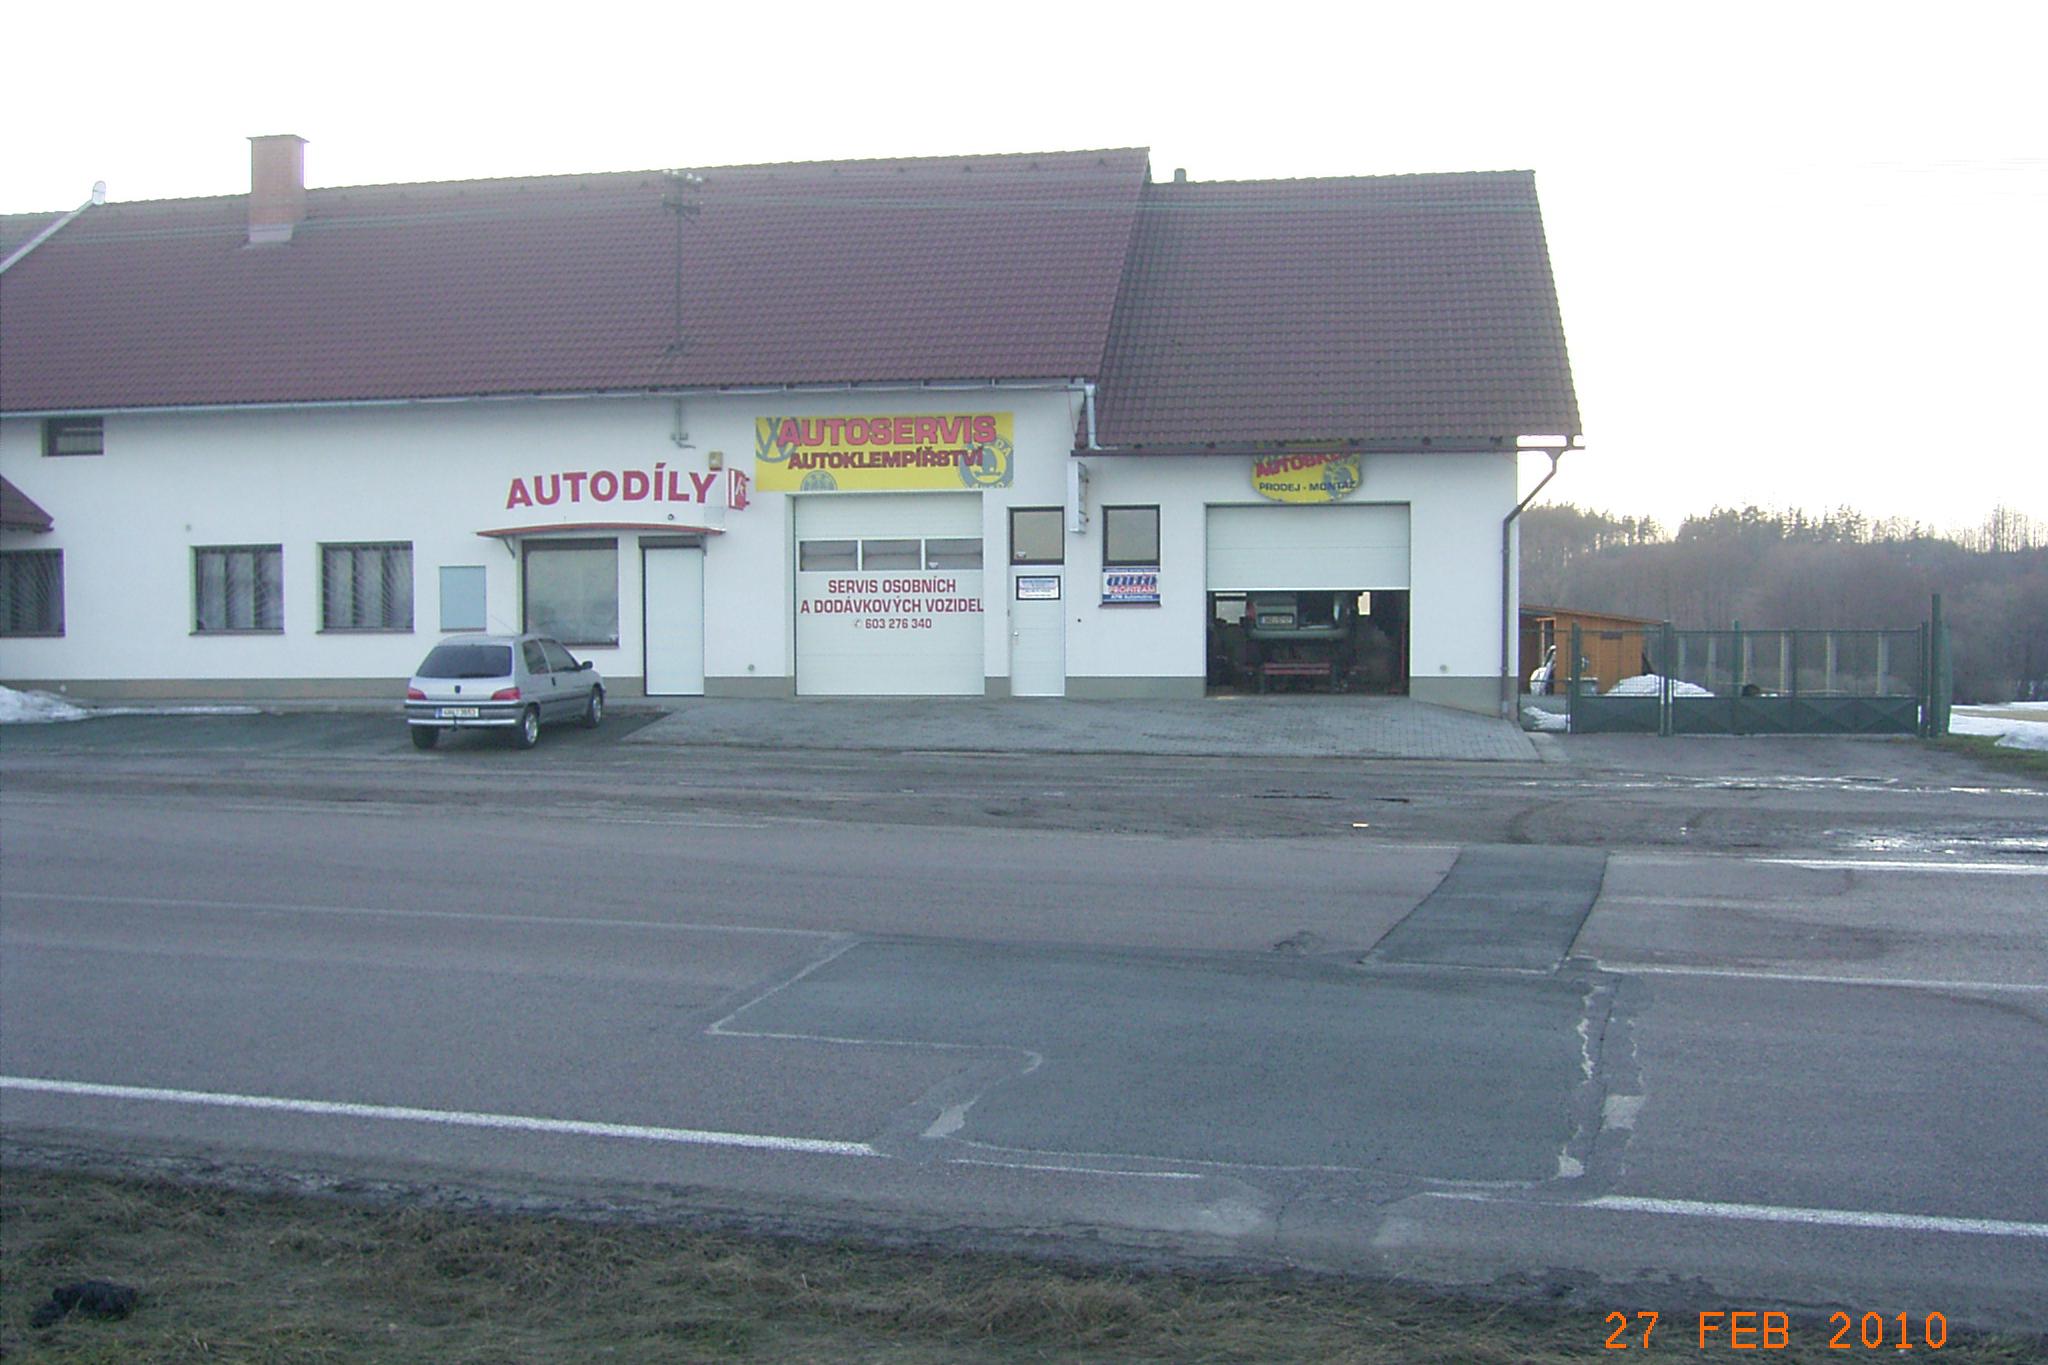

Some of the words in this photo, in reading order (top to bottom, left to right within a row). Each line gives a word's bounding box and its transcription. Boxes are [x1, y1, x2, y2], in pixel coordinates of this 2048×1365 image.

[776, 416, 996, 447] AUTOSERVIS
[506, 462, 717, 509] AUTODÍLY
[1259, 481, 1301, 492] PRODEJ
[828, 579, 878, 594] SERVIS
[882, 576, 956, 593] OSOBNÍCH
[800, 600, 810, 614] A
[814, 596, 921, 614] DODÁVKOVÝCH
[926, 598, 985, 613] VOZIDEL
[865, 618, 886, 629] 603
[888, 618, 909, 629] 276
[911, 618, 932, 629] 340
